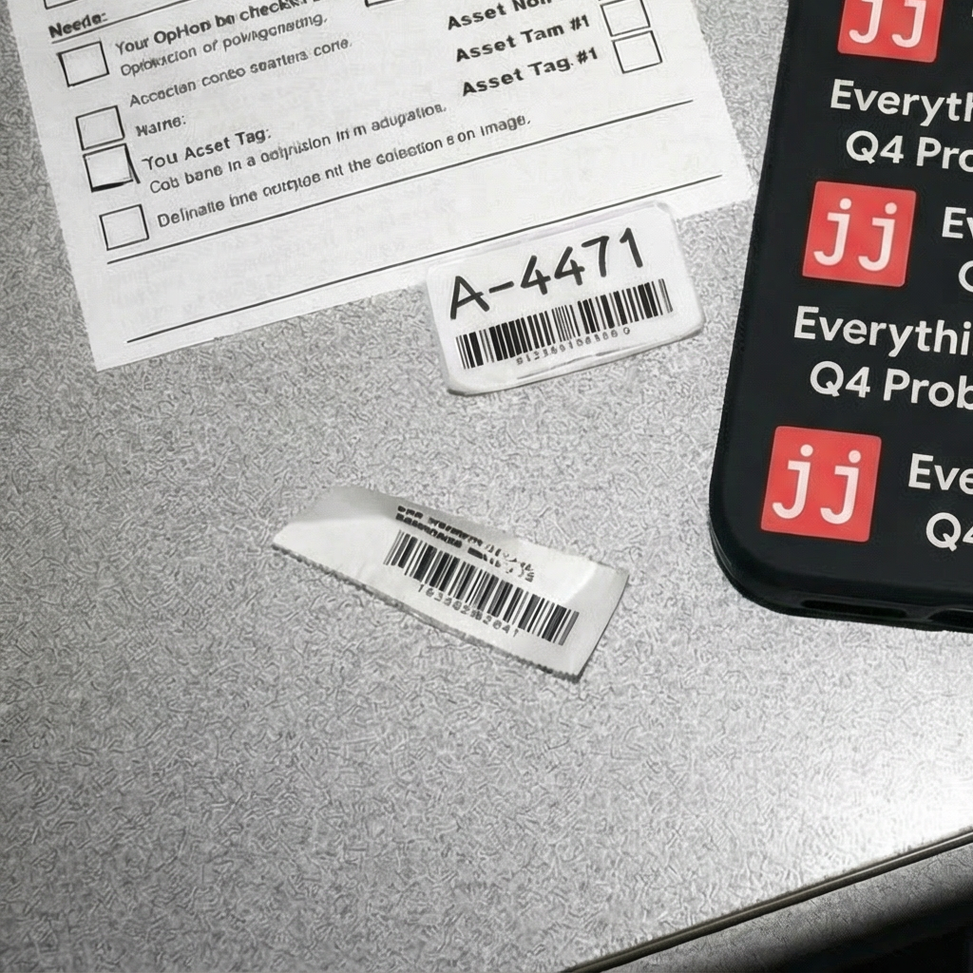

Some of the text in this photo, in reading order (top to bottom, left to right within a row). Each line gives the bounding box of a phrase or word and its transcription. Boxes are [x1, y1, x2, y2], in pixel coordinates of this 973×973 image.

[448, 2, 507, 30] Asset
[115, 37, 150, 56] Your
[456, 14, 590, 63] Asset Tam #1
[462, 68, 525, 96] Asset
[576, 46, 598, 65] #1
[348, 158, 371, 173] the
[457, 129, 476, 143] on
[846, 130, 904, 165] Q4
[450, 227, 643, 320] A-4471
[809, 360, 871, 397] Q4
